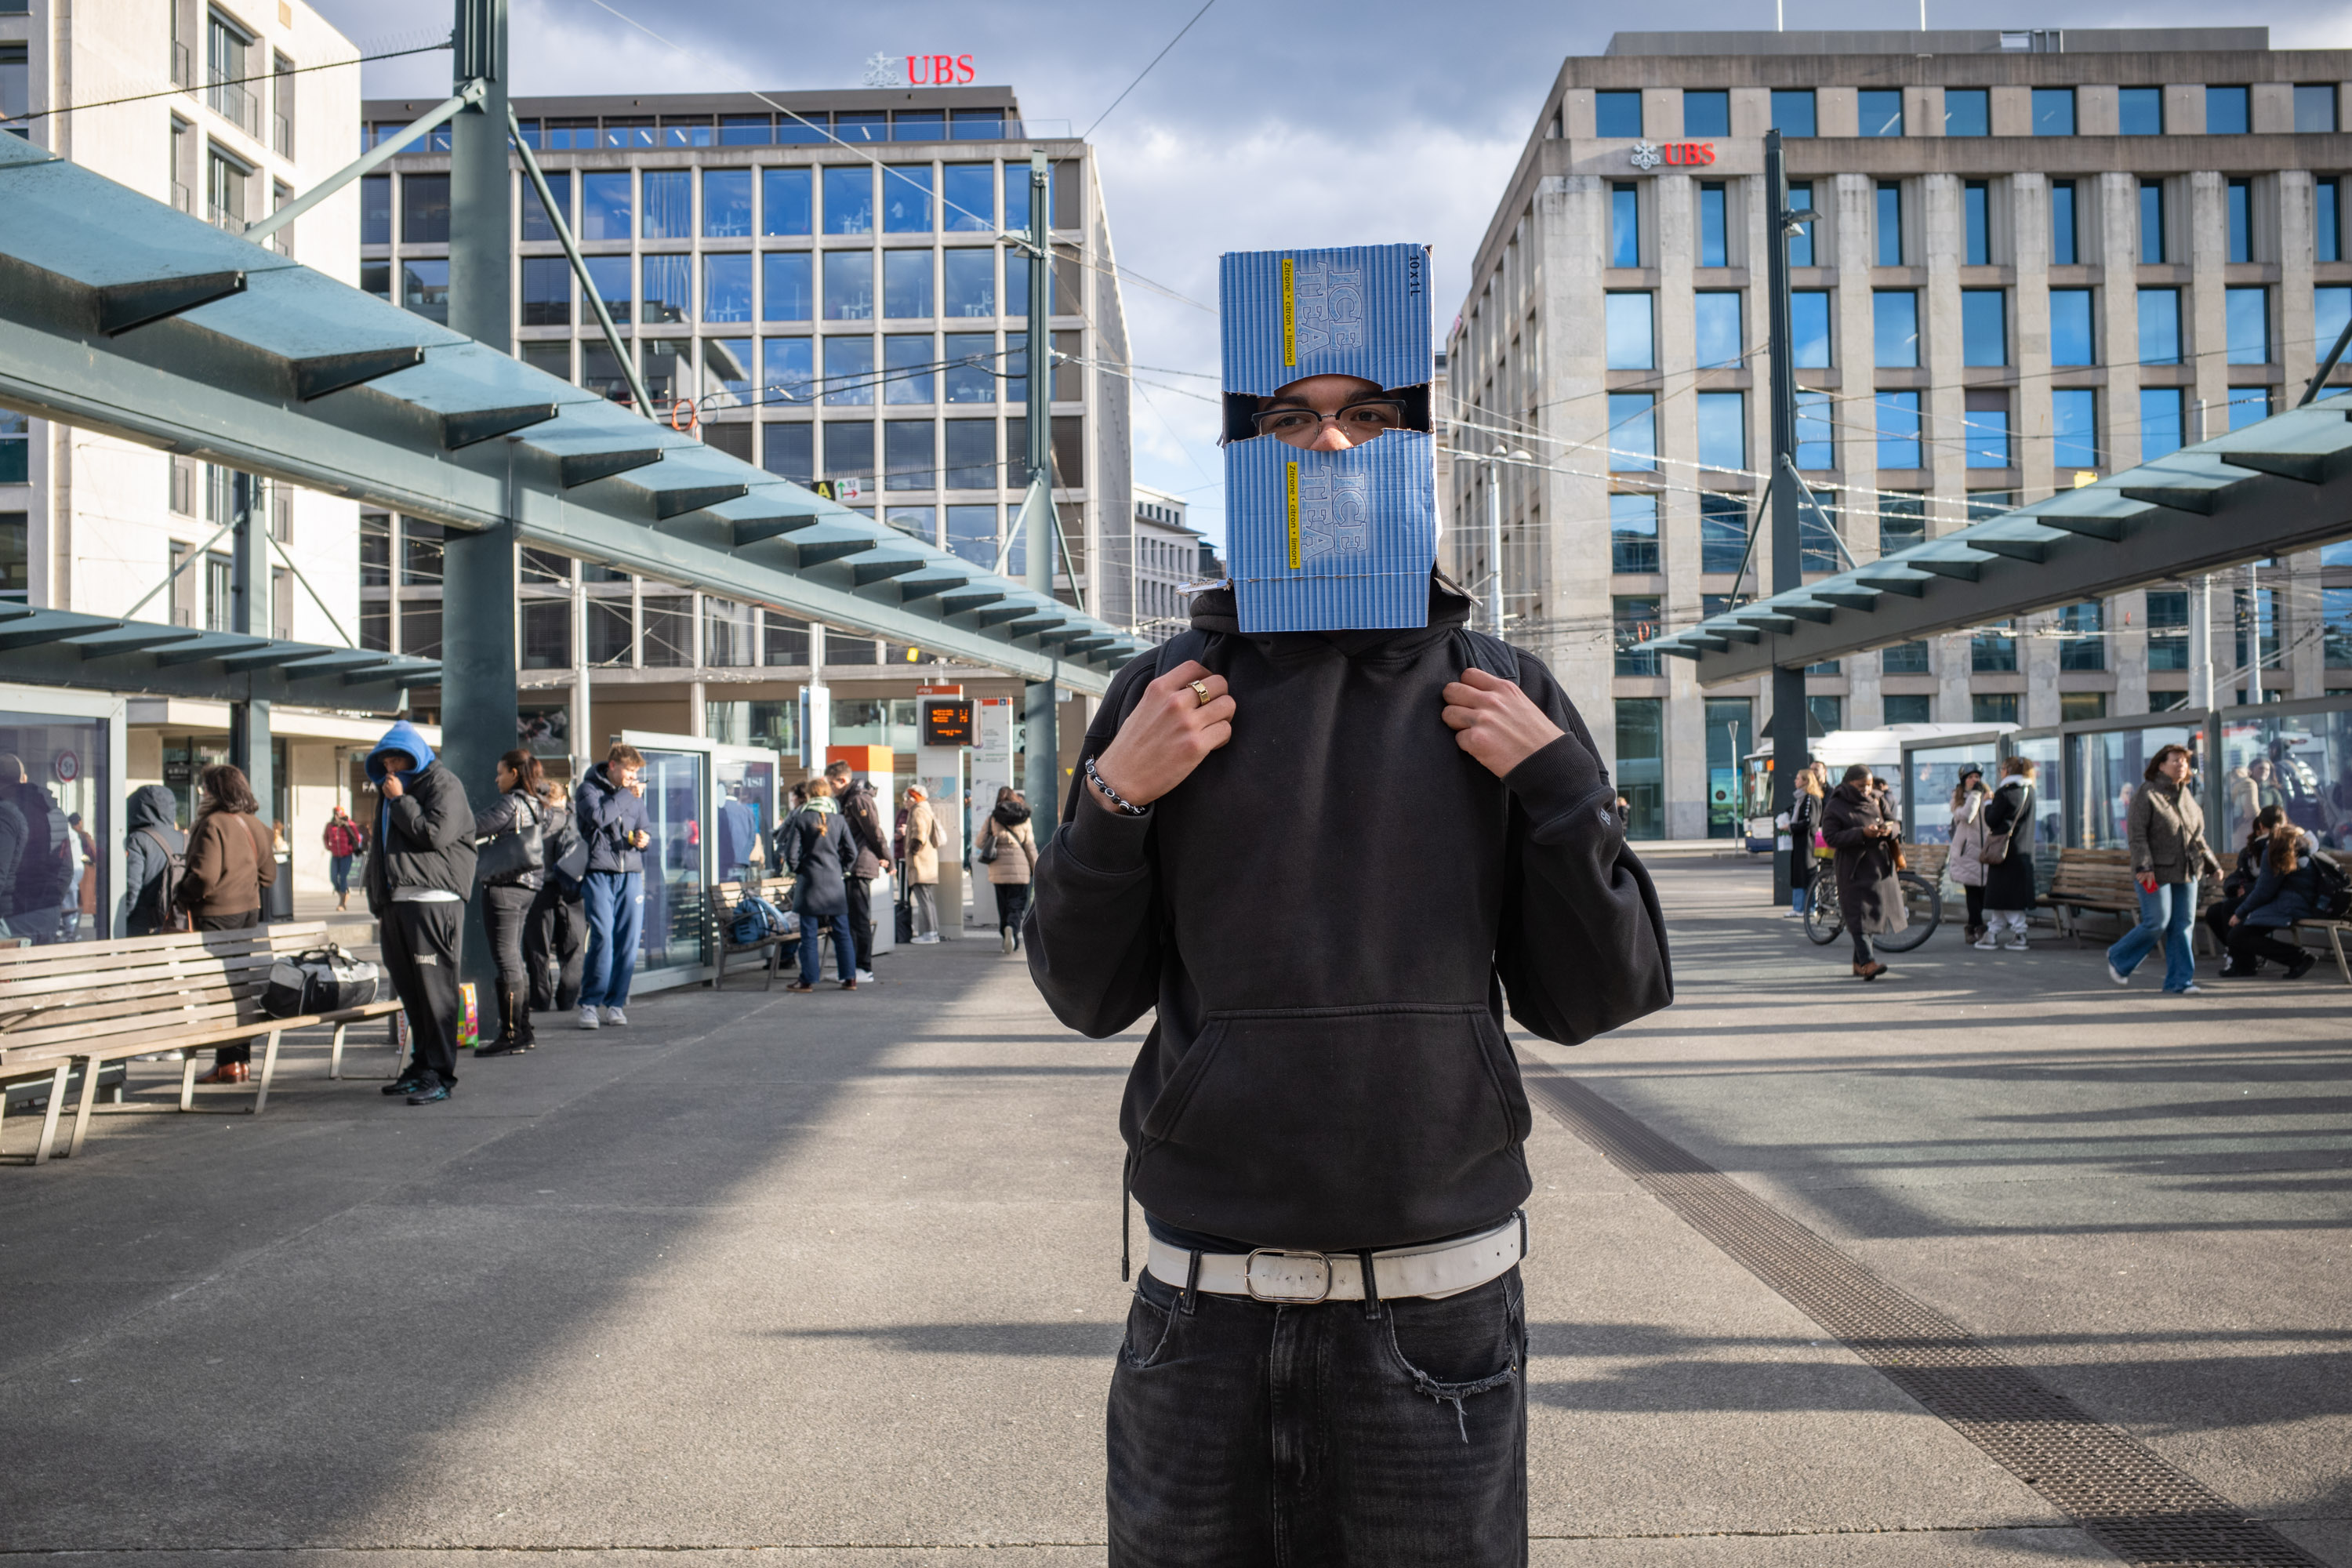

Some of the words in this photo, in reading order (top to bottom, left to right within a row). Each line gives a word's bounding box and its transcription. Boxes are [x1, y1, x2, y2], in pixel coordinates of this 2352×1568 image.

[906, 54, 975, 84] UBS
[1664, 143, 1715, 165] UBS
[1295, 260, 1330, 358] TEA
[1328, 269, 1363, 350] ICE
[818, 482, 831, 499] A
[1300, 464, 1334, 561] TEA
[1333, 473, 1367, 554] ICE
